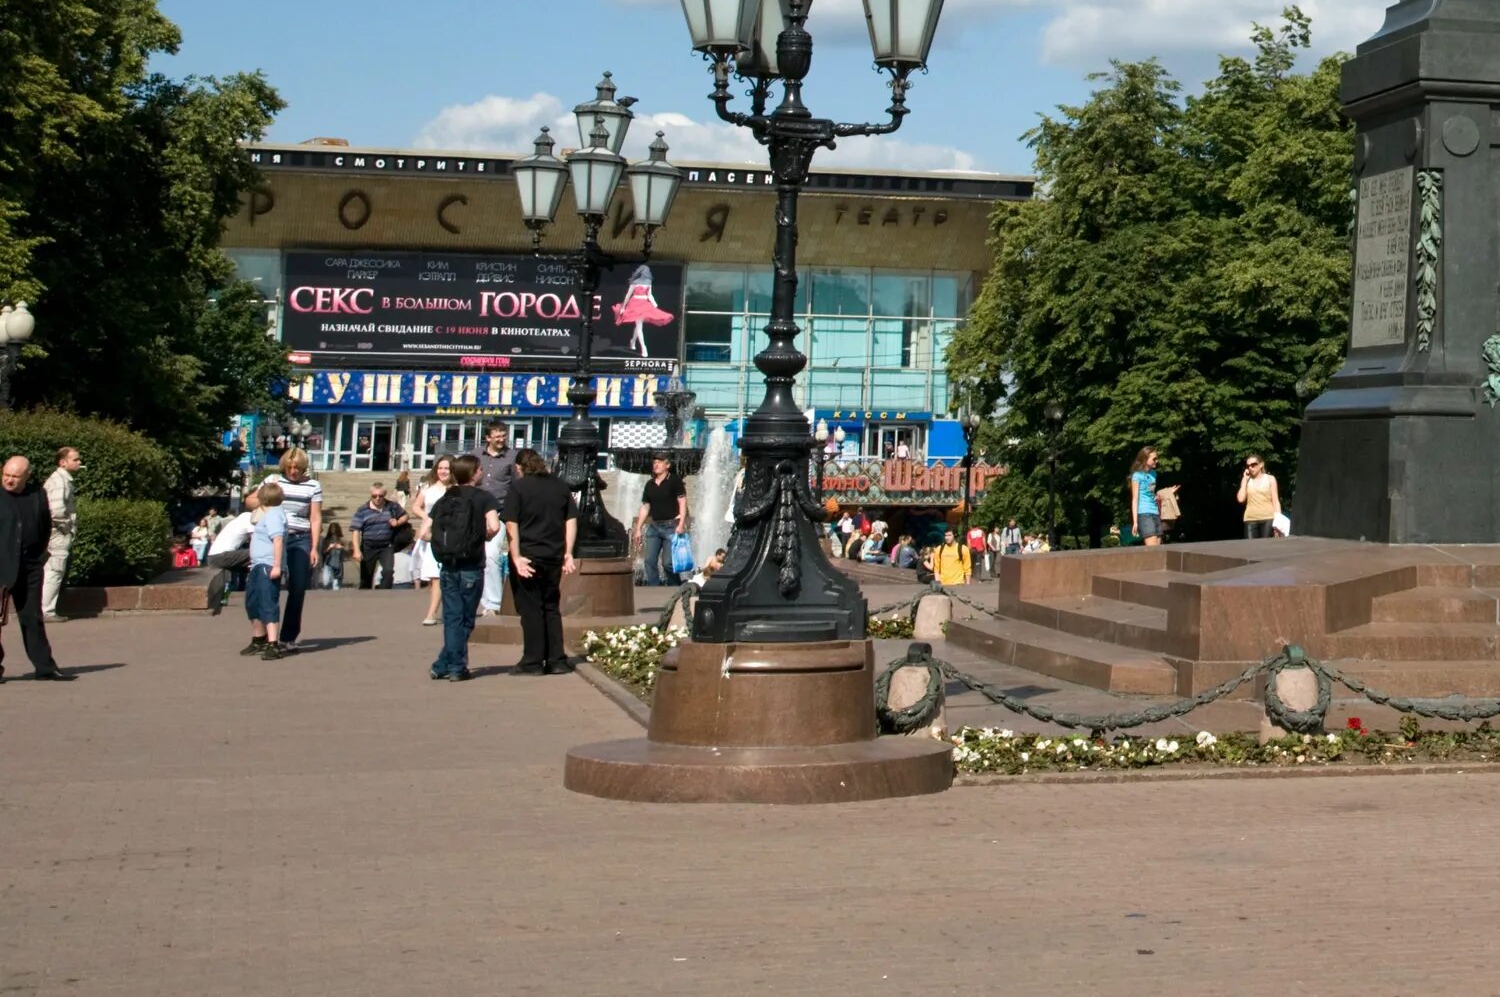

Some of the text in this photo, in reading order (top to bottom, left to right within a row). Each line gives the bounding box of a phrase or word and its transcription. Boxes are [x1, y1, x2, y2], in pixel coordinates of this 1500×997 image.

[251, 153, 773, 185] НЯ СМОТРИТЕ ПАСЕН
[248, 187, 949, 243] РОСИЯ ТЕАТР
[325, 257, 401, 269] САРА ДЖЕССИКА
[427, 260, 449, 269] КИМ
[475, 262, 517, 272] КРИСТИН
[347, 270, 378, 280] ПАРКЕР
[418, 272, 456, 281] КЭТРАЛЛ
[475, 272, 515, 284] ДЕЙВИС
[535, 275, 575, 285] НИКСОН
[289, 285, 375, 314] СЕКС
[381, 296, 391, 309] В
[395, 297, 472, 311] БОЛЬШОМ
[320, 322, 571, 337] НАЗНАЧАЙ СВИДАНИЕ С 19 ИЮНЯ В КИНОТЕАТРАХ
[624, 359, 667, 368] SEPHORA
[435, 406, 519, 415] КИНОТЕАТР
[833, 411, 906, 420] КАССЫ
[884, 458, 1009, 498] Шангр
